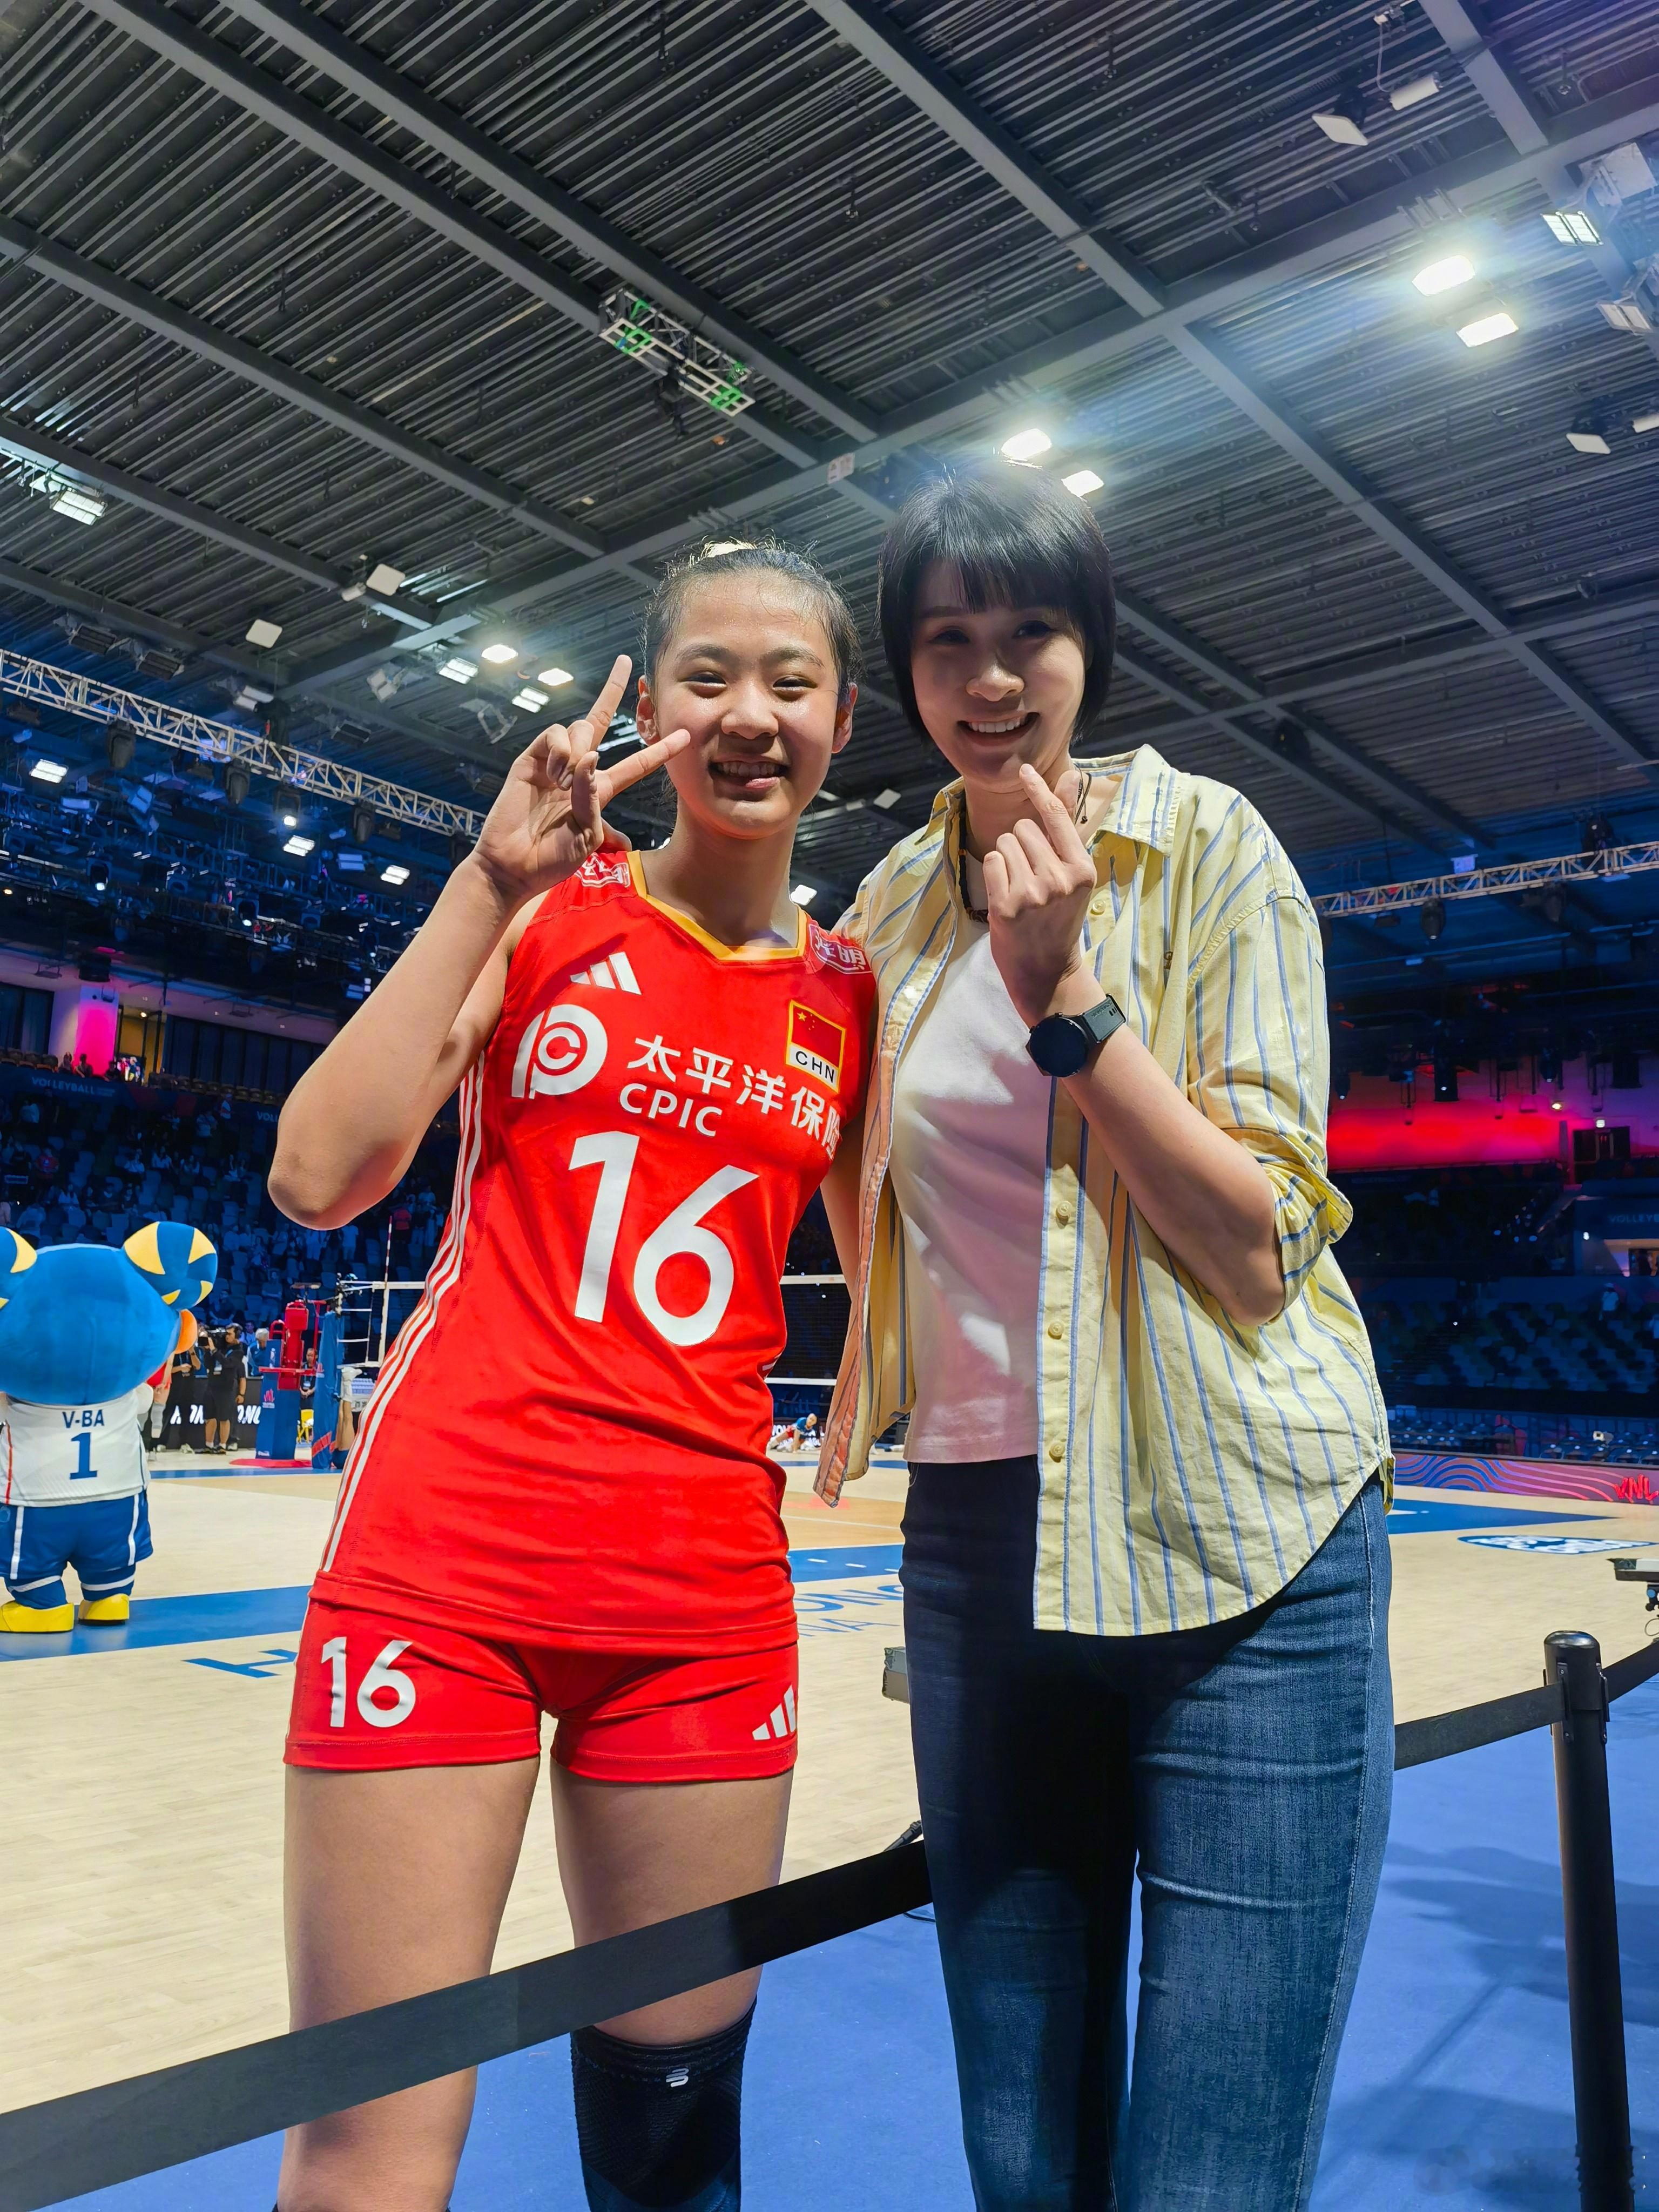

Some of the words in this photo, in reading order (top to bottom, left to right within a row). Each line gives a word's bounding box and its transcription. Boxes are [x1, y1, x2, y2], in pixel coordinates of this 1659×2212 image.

[31, 1076, 95, 1095] VOLLEYBALL
[795, 1049, 836, 1085] CHN
[619, 1083, 723, 1138] CPIC
[568, 1131, 760, 1347] 16
[62, 1408, 105, 1429] V-BA
[70, 1432, 98, 1480] 1
[1614, 1474, 1659, 1500] VNL
[321, 1636, 416, 1728] 16
